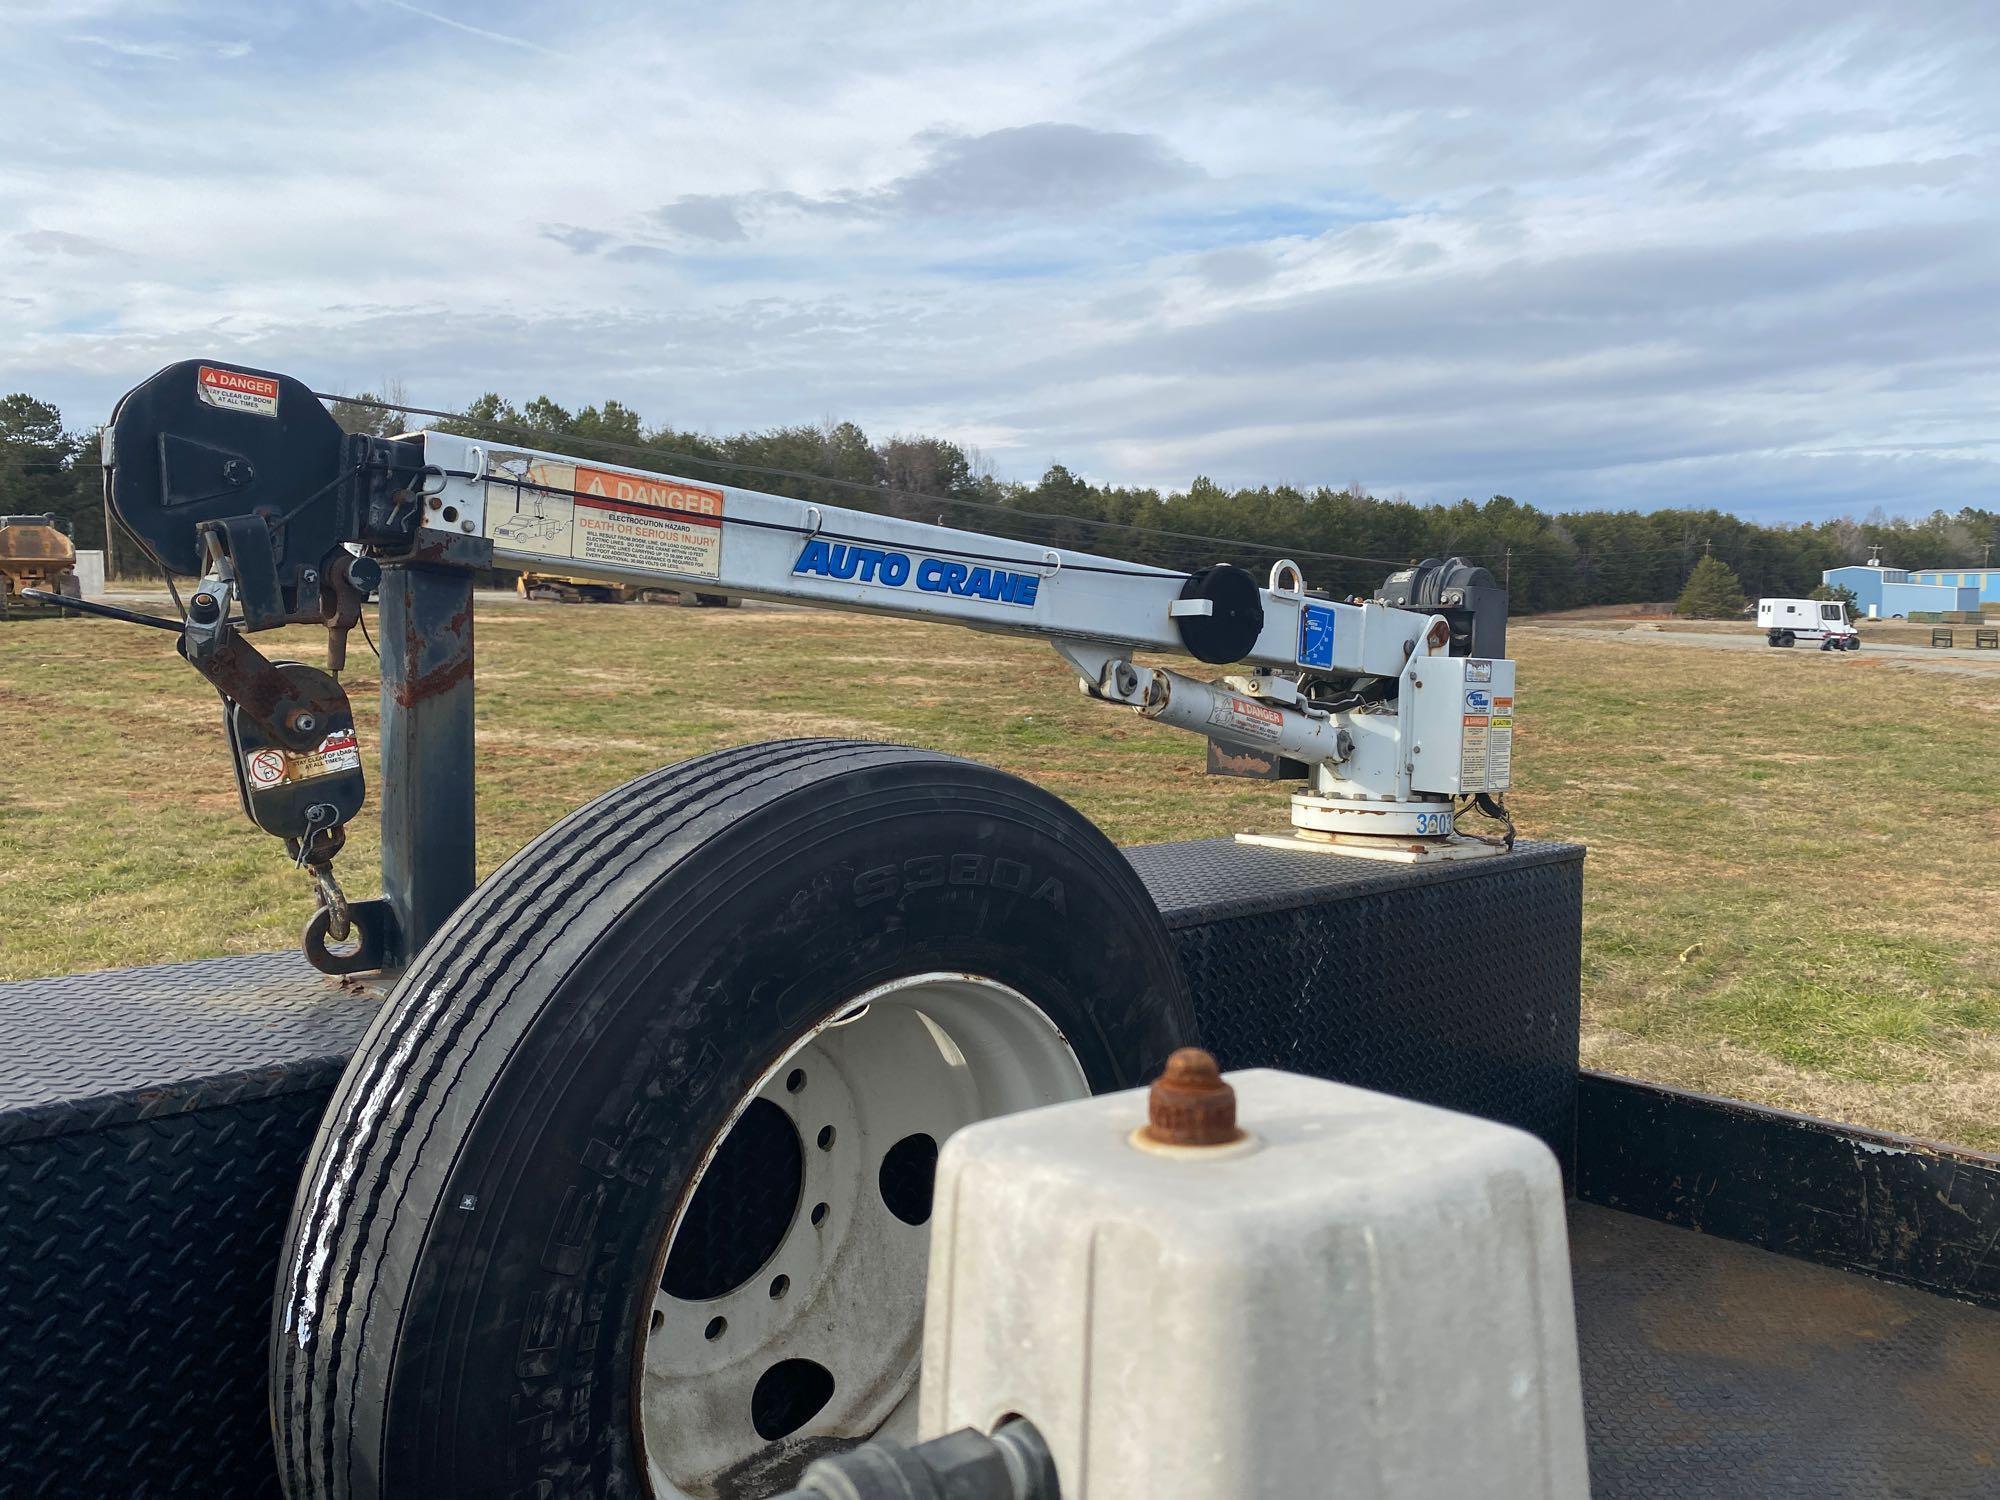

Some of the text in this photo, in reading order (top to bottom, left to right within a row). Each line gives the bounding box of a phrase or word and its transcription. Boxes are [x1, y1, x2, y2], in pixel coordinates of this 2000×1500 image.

[220, 375, 273, 394] DANGER
[222, 391, 241, 399] CLEAR
[240, 400, 258, 408] TIMES
[617, 481, 714, 515] DANGER
[609, 514, 690, 532] ELECTROCUTION HAZARD
[580, 518, 716, 547] DEATH OR SERIOUS INJURY
[586, 536, 609, 544] ELECTRIC
[632, 548, 655, 556] CARRYING
[680, 545, 708, 553] CONTACTING
[602, 554, 629, 562] ADDITIONAL
[611, 550, 638, 558] ADDITIONAL
[639, 554, 666, 562] CLEARANCE
[793, 540, 1040, 606] AUTO CRANE
[1246, 704, 1280, 723] DANGER
[308, 752, 327, 763] CLEAR
[337, 748, 352, 757] LOAD
